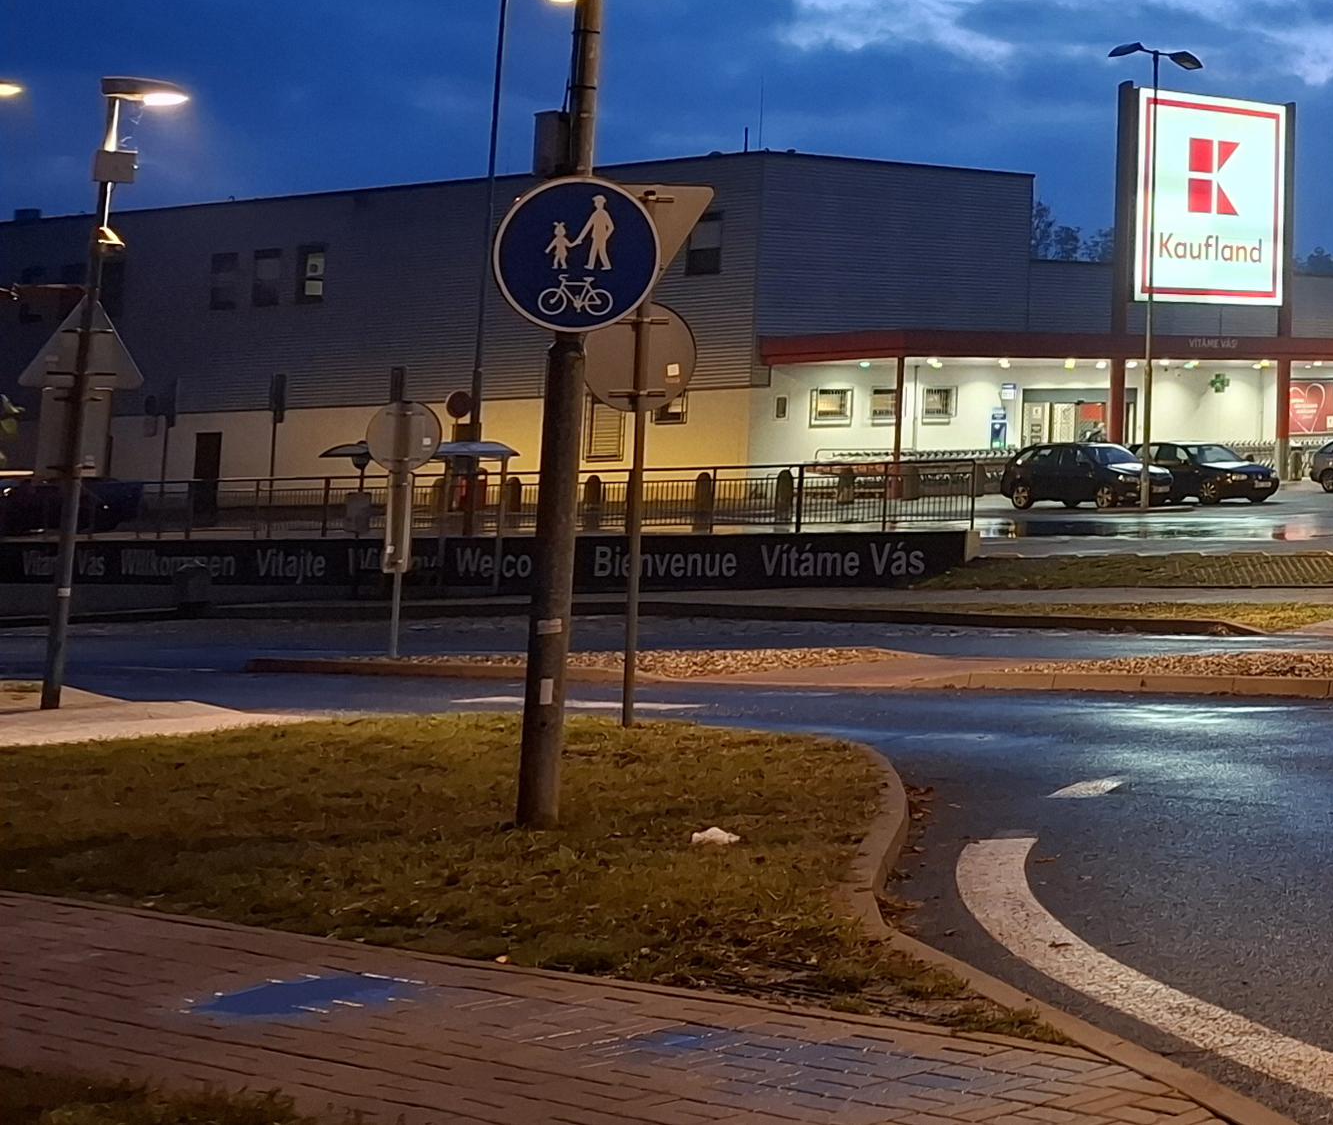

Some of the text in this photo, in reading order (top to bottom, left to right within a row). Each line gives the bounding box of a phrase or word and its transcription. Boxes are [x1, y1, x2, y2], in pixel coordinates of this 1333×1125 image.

[1158, 231, 1263, 264] Kaufland
[256, 547, 327, 584] Vitajte
[760, 542, 860, 577] Vítáme
[869, 541, 926, 576] Vás
